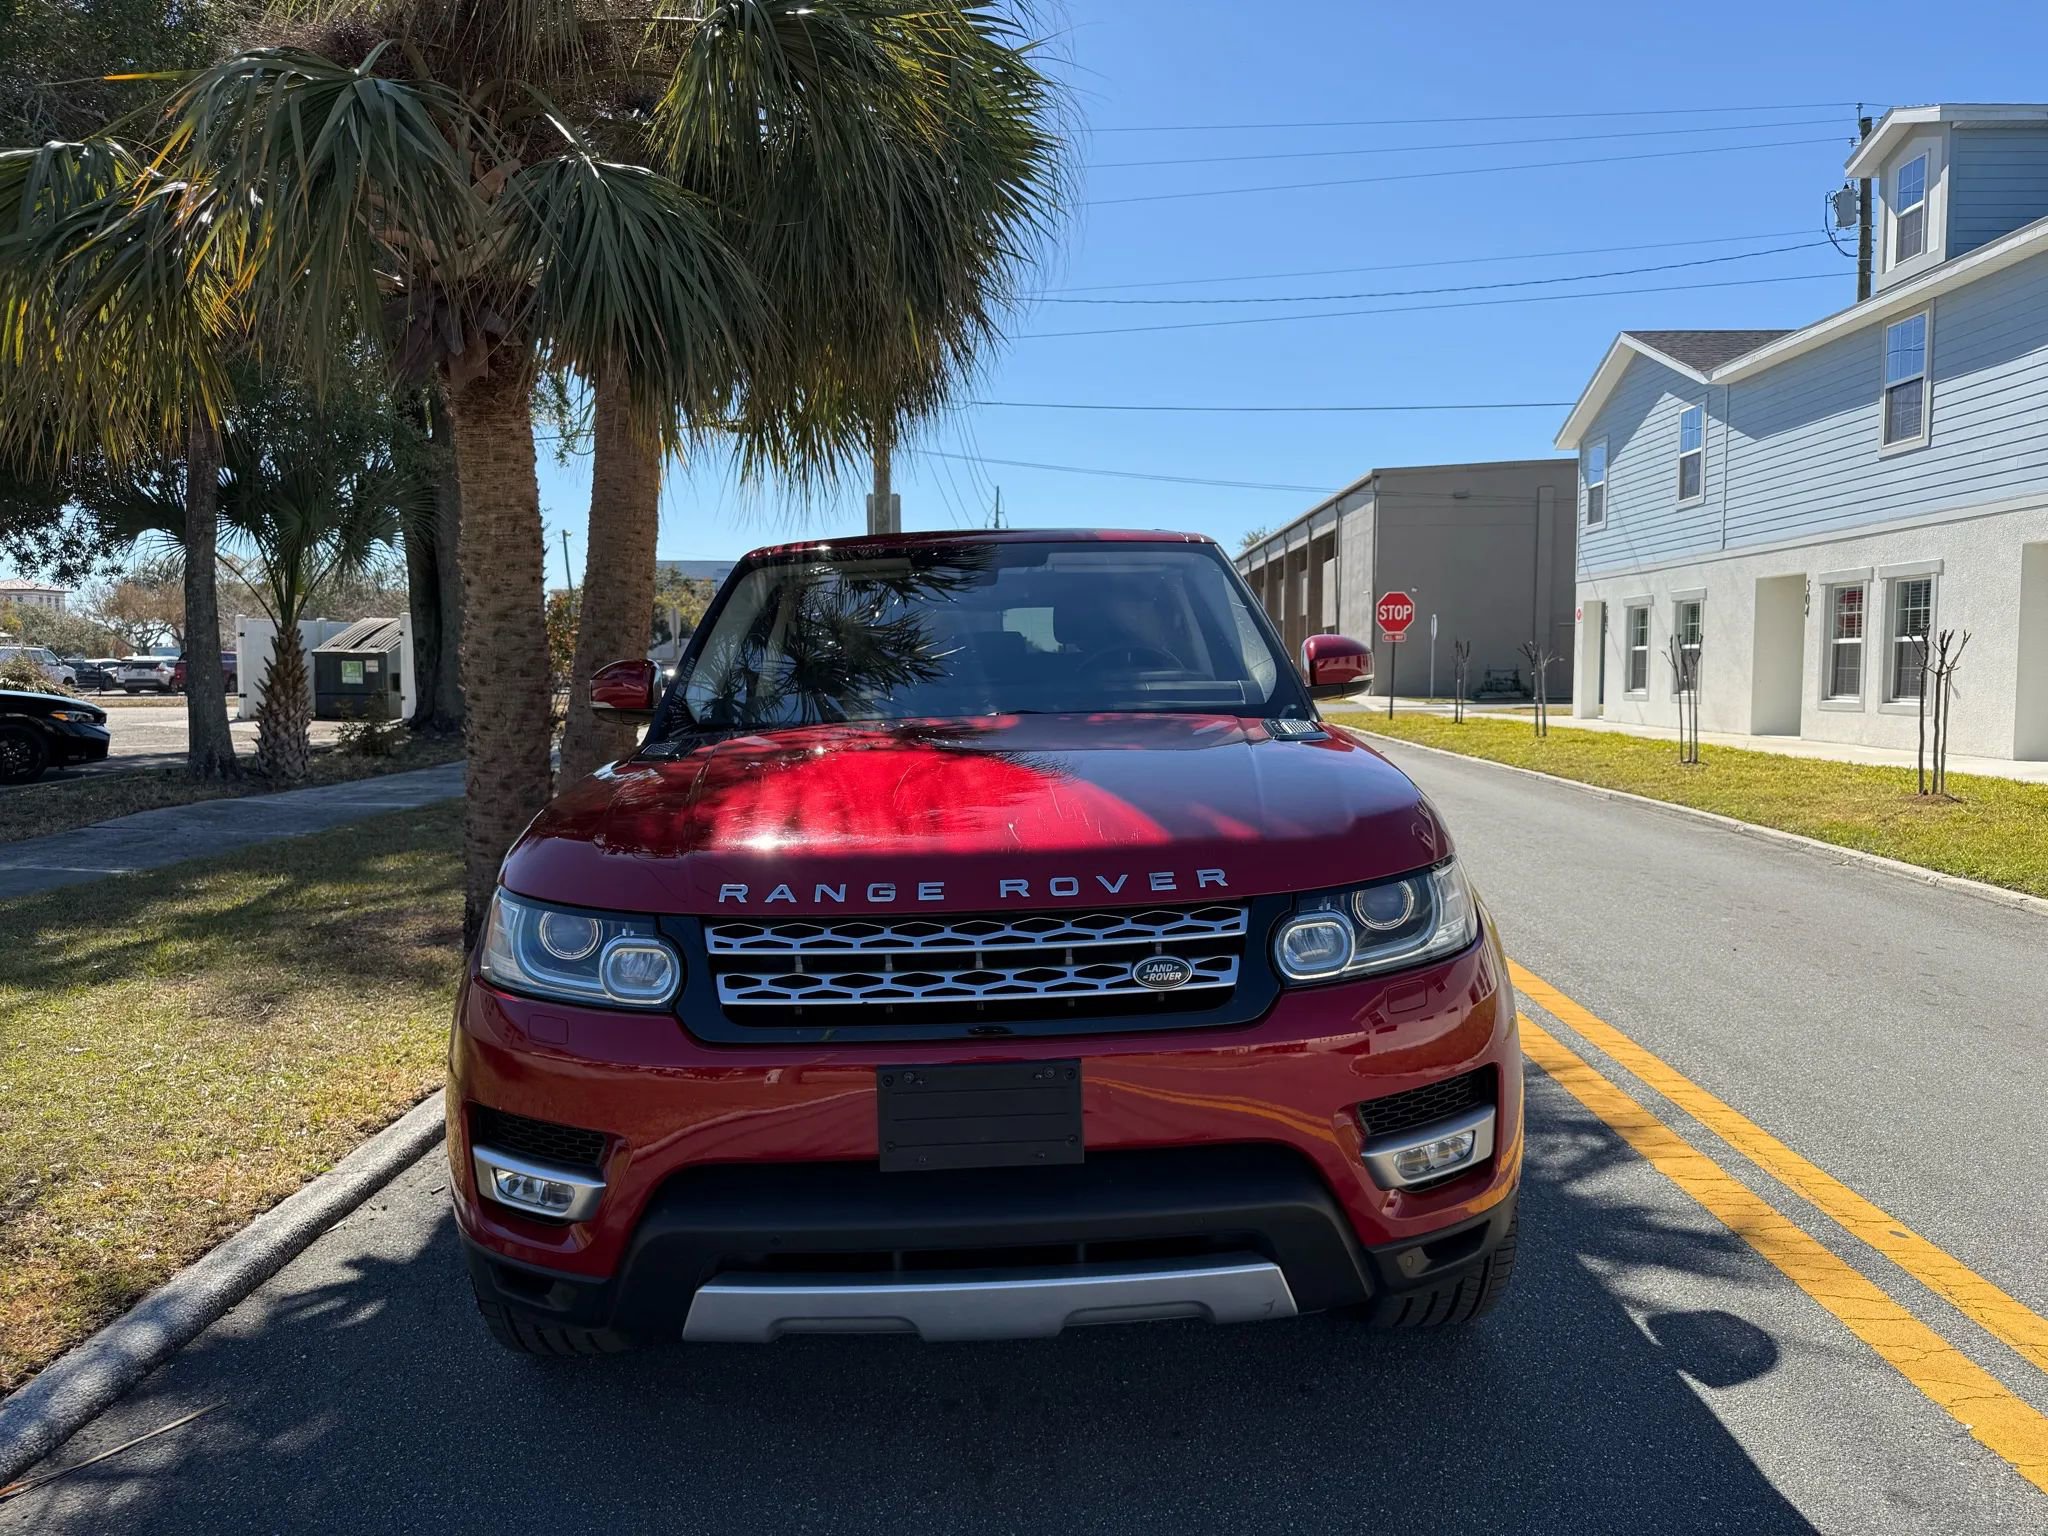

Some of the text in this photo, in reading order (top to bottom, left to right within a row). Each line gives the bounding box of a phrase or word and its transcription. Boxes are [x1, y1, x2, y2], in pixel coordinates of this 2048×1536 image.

[1379, 605, 1412, 620] STOP
[718, 868, 1229, 903] RANGE ROVER
[1146, 963, 1173, 973] LAND
[1148, 972, 1182, 982] ROVER
